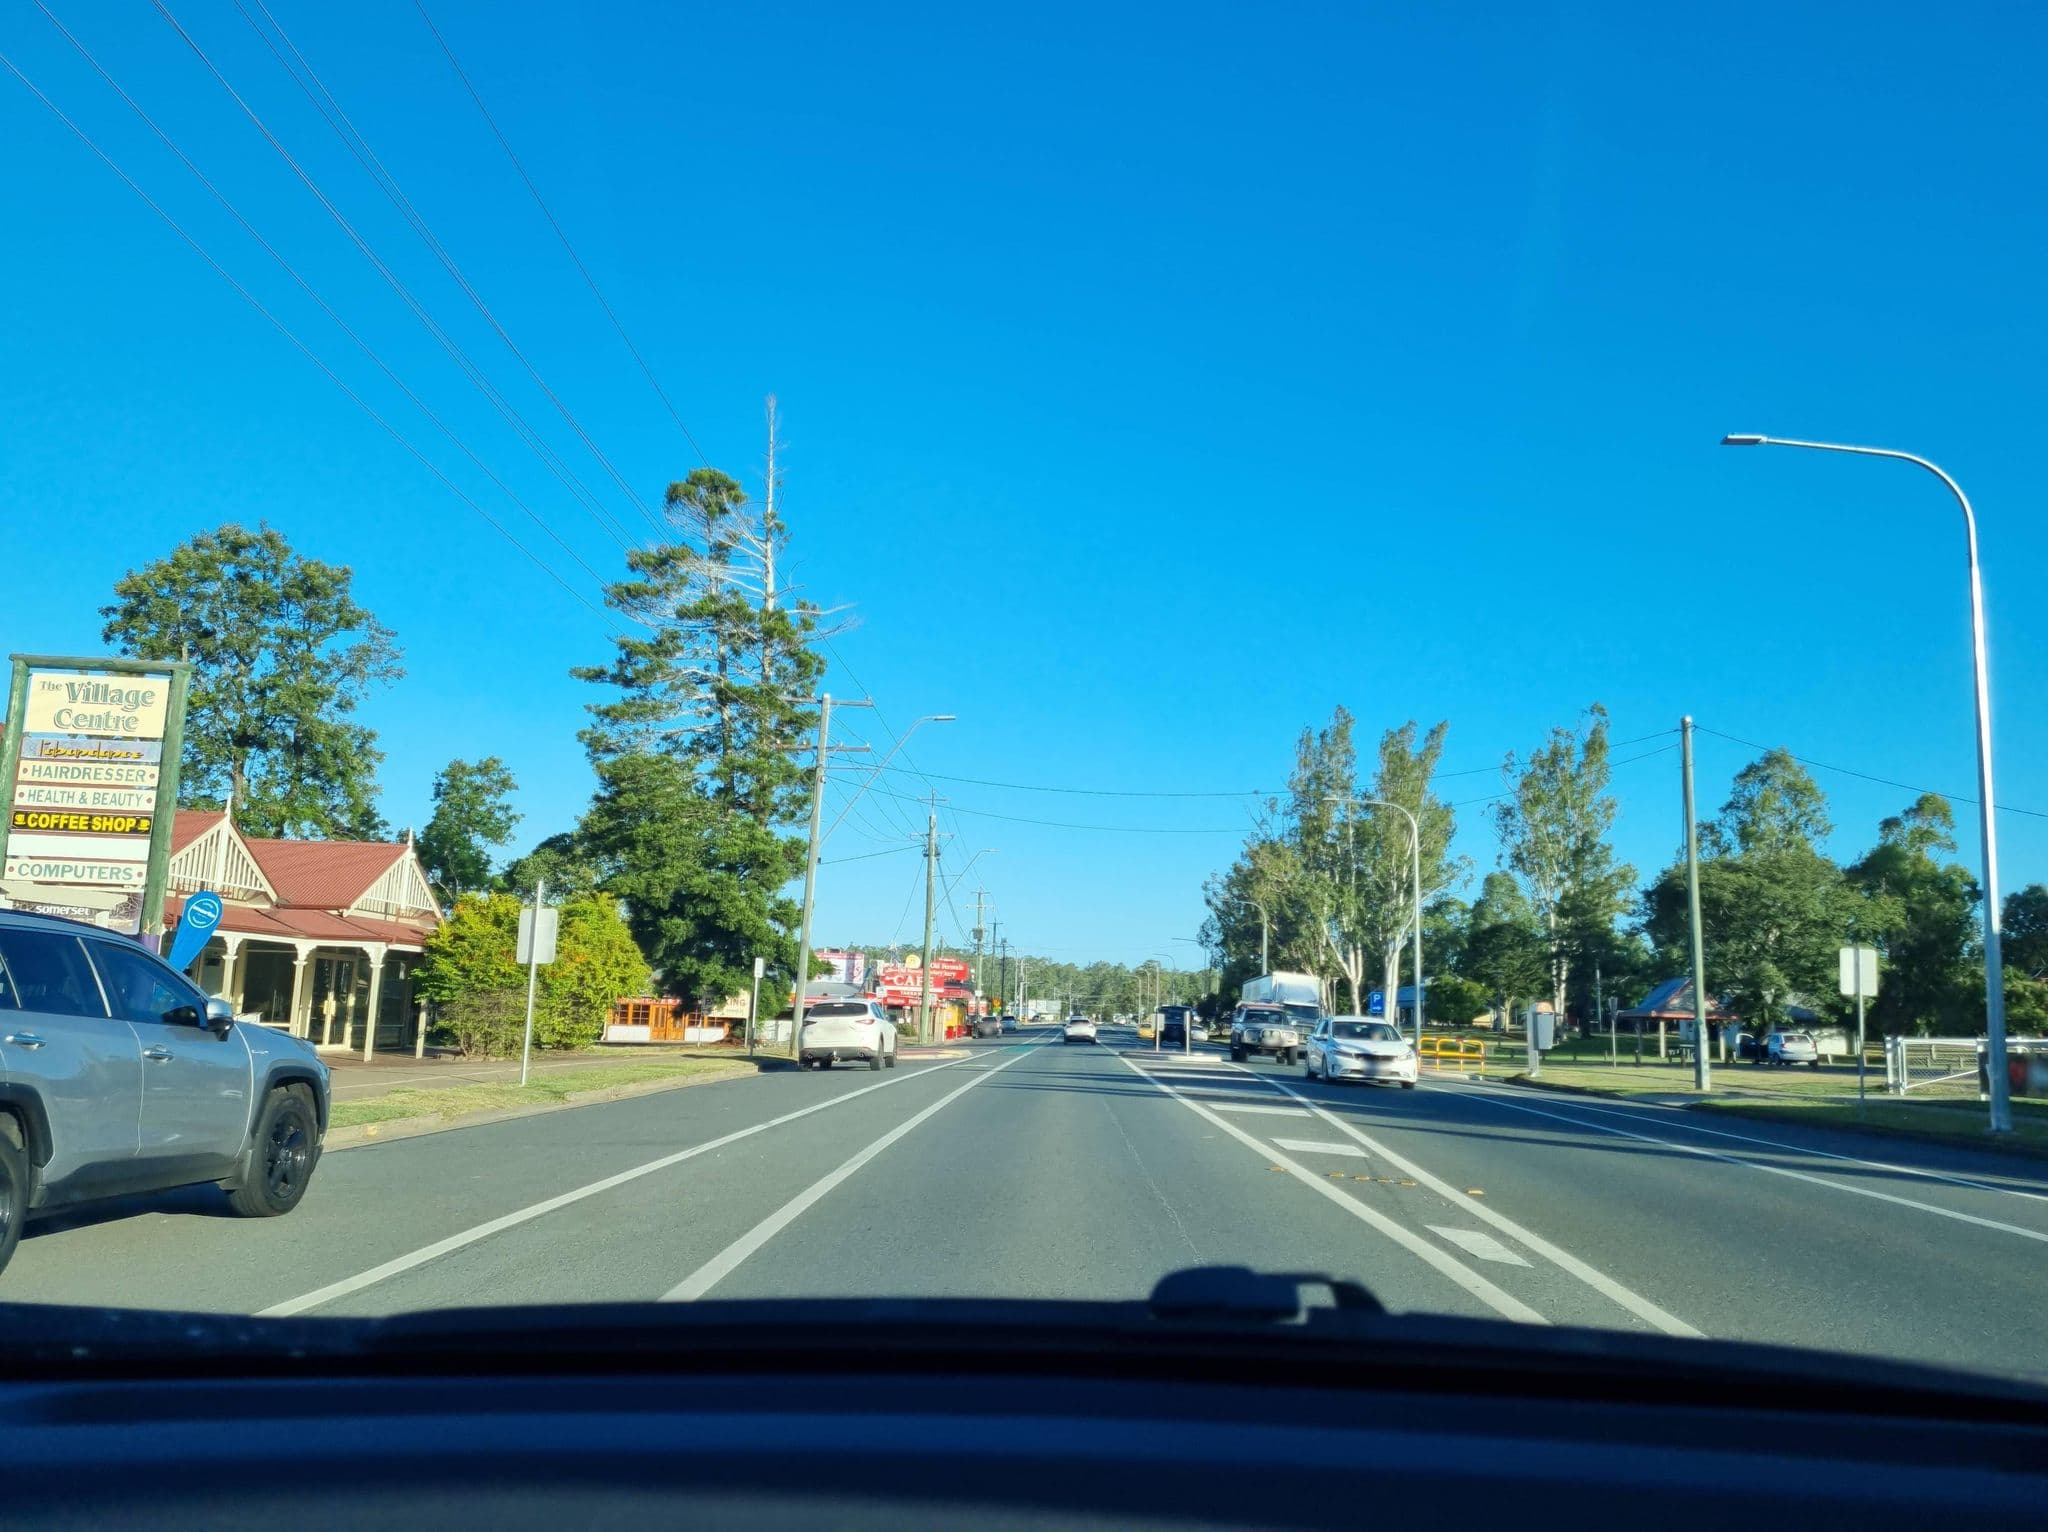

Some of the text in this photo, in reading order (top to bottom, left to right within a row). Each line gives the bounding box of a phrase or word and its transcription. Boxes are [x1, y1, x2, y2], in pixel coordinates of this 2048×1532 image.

[40, 680, 156, 711] The Village
[54, 708, 139, 732] Centre
[31, 764, 146, 782] HAIRDRESSER
[27, 789, 143, 807] HEALTH & BEAUTY
[27, 812, 137, 832] COFFEE SHOP
[17, 862, 133, 881] COMPUTERS
[35, 904, 90, 916] somerset
[1373, 994, 1381, 1003] P
